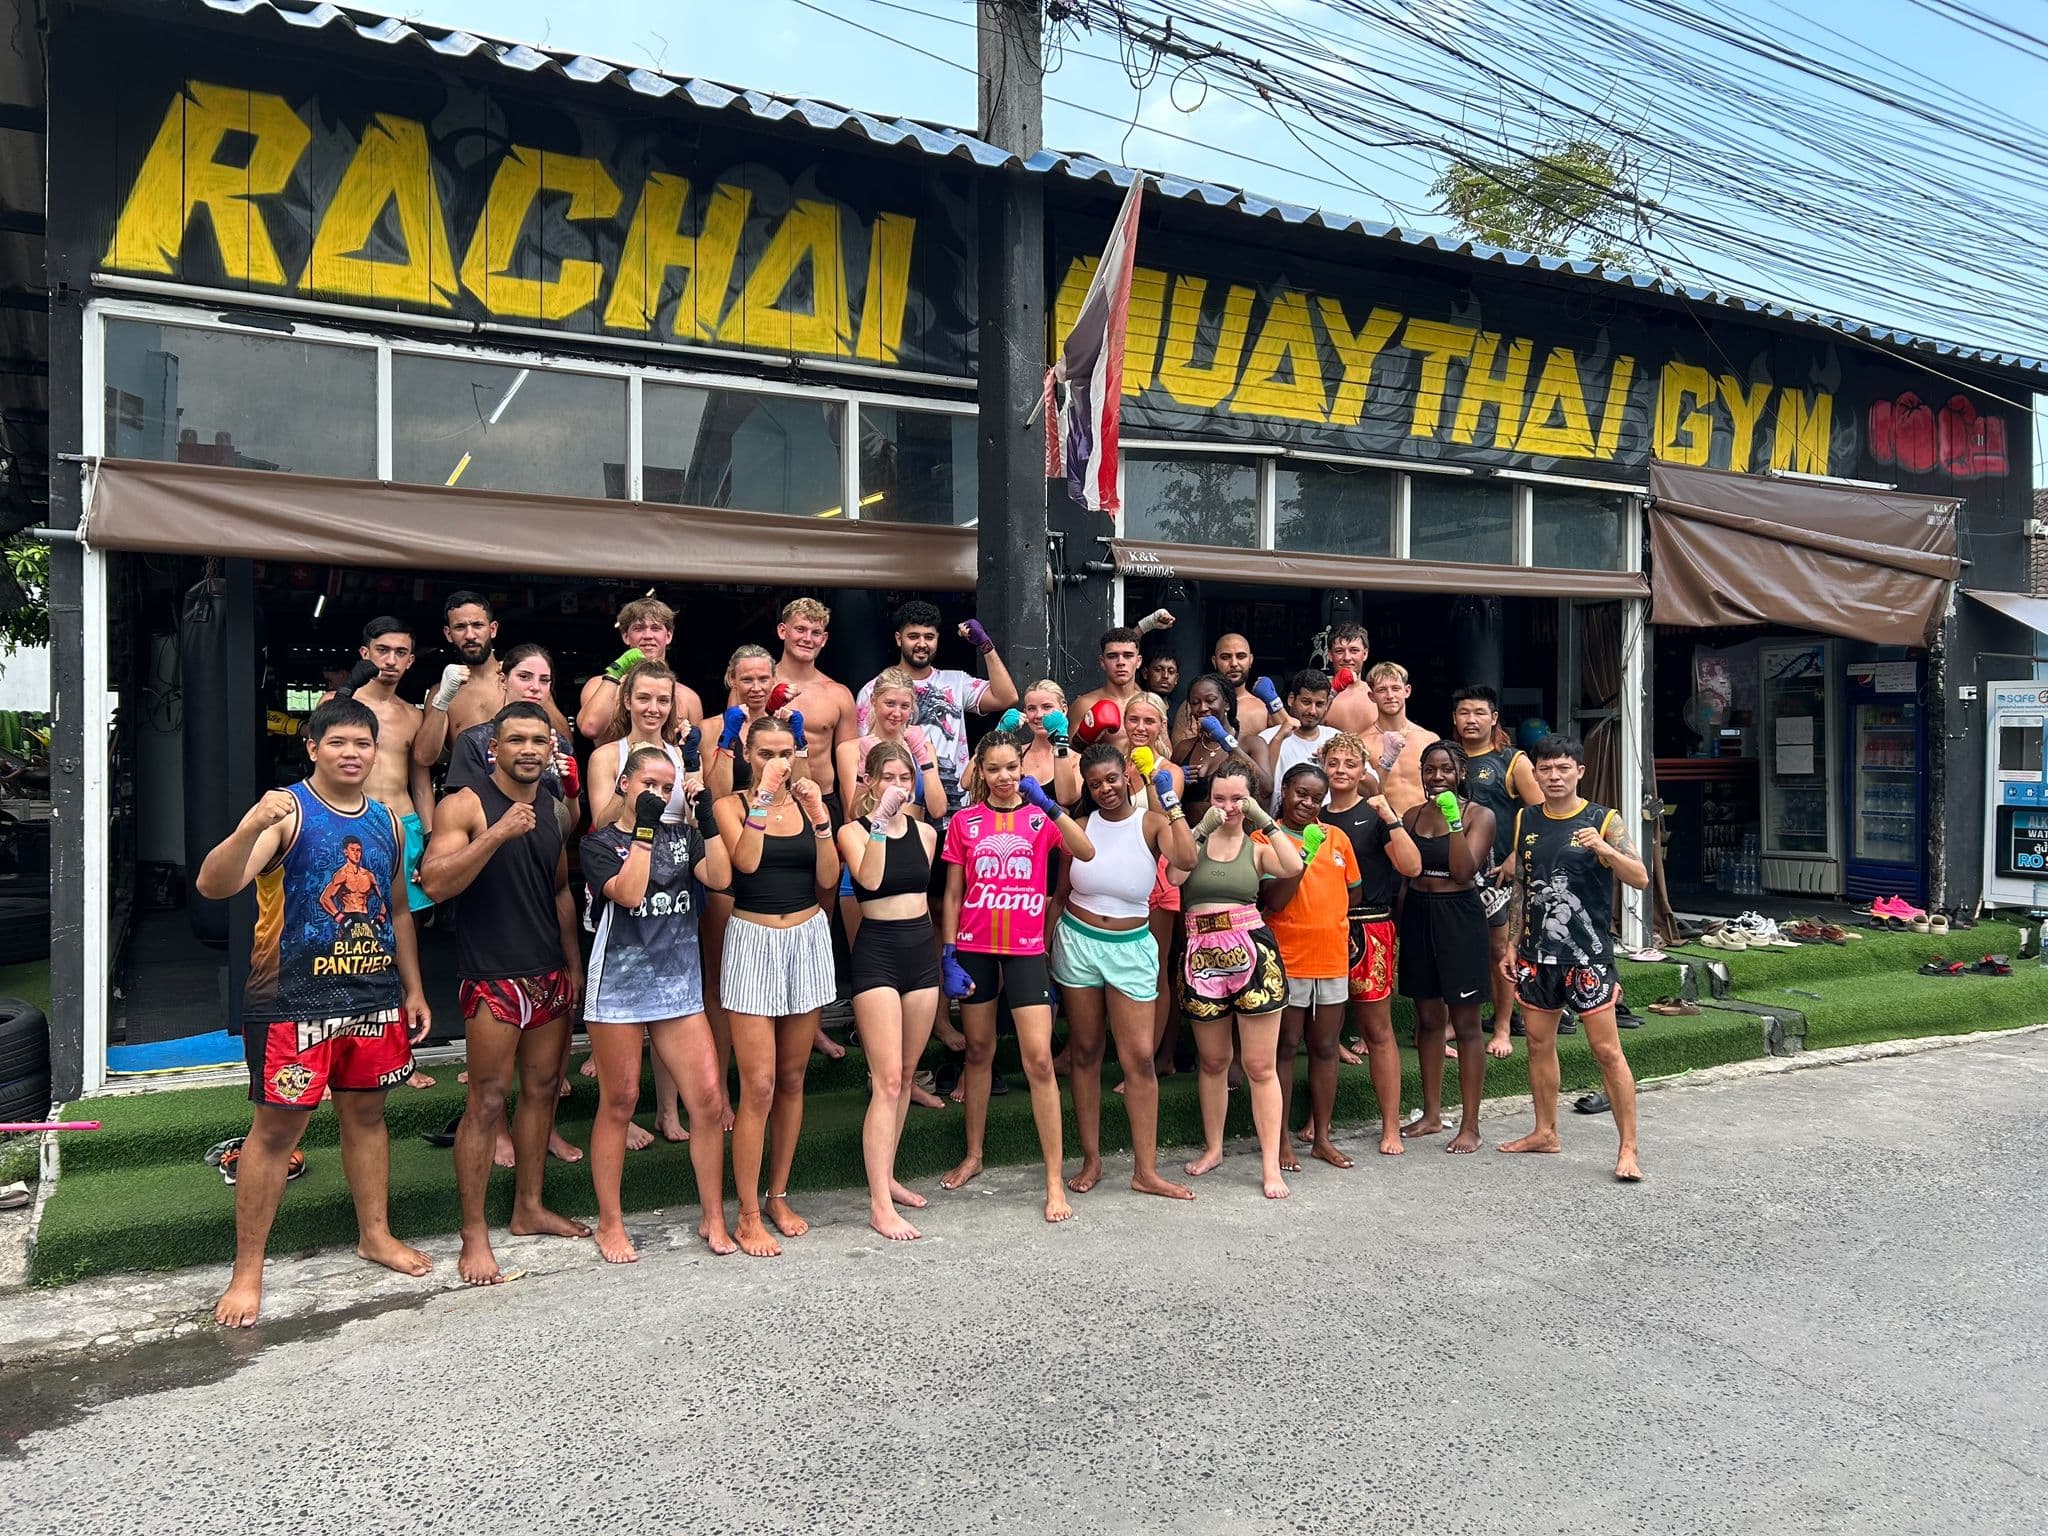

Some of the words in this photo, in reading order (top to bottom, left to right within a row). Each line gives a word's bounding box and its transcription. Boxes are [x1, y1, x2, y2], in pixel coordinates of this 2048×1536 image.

[100, 80, 916, 363] RACHAI
[1401, 319, 1635, 460] THAI
[1653, 361, 1833, 475] GYM
[1128, 550, 1160, 562] K&K
[969, 825, 979, 838] 9
[2018, 853, 2044, 869] RO
[964, 881, 1045, 917] Chang
[957, 931, 974, 941] rue
[334, 940, 380, 955] BLACK
